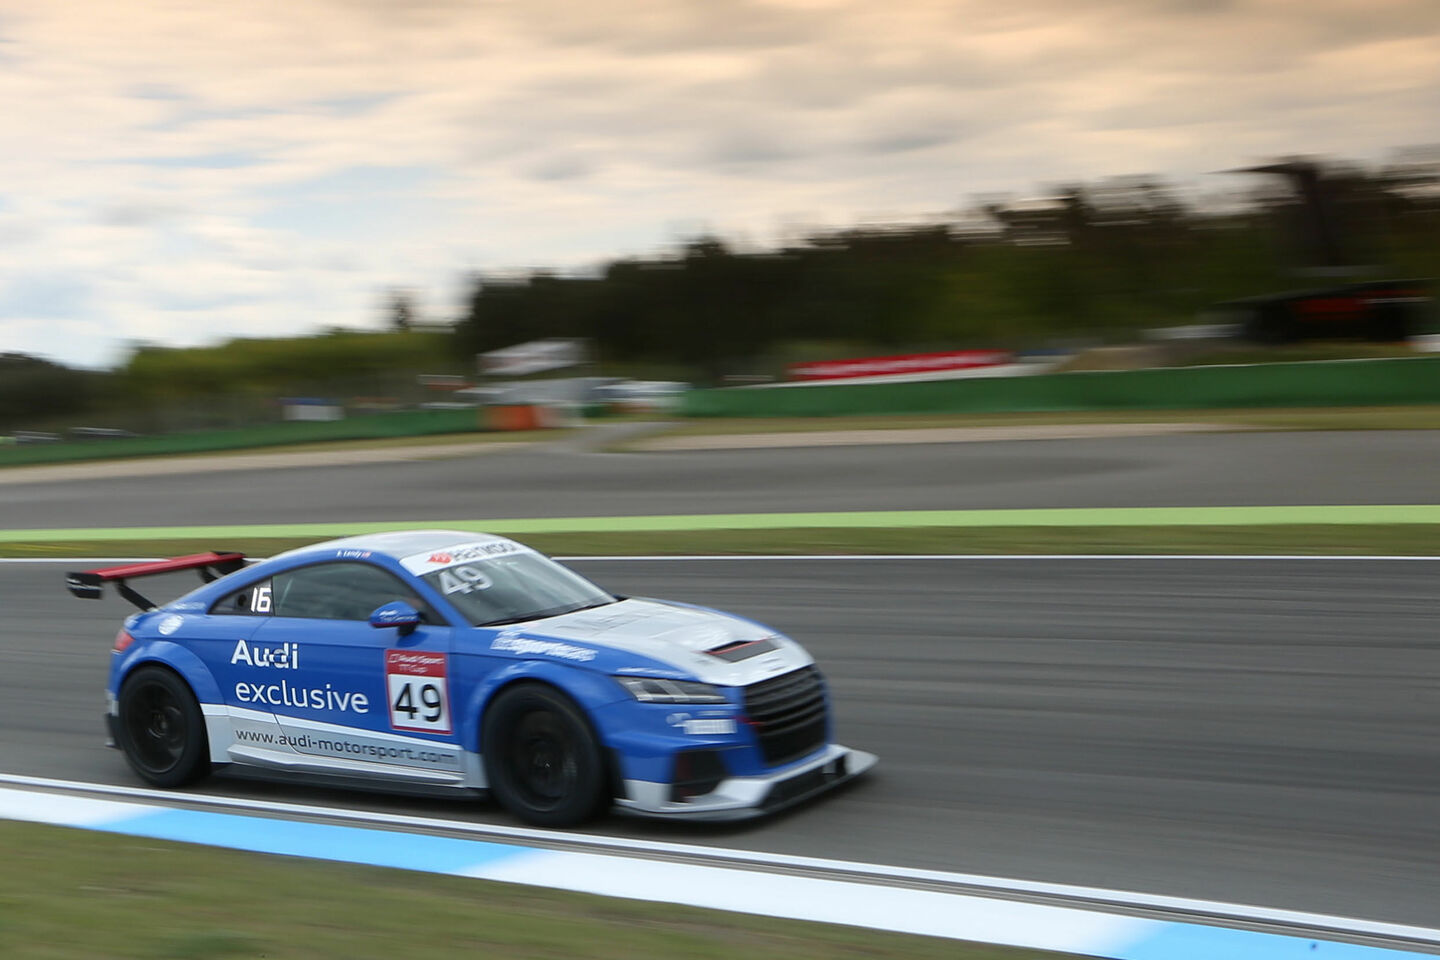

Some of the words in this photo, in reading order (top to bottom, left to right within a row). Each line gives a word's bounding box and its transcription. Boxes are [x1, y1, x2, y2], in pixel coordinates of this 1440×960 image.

[439, 566, 493, 595] 49
[250, 587, 272, 613] 16
[230, 639, 299, 669] Audi
[235, 679, 369, 714] exclusive
[393, 683, 442, 723] 49
[236, 728, 459, 764] www.audi-motorsport.com
